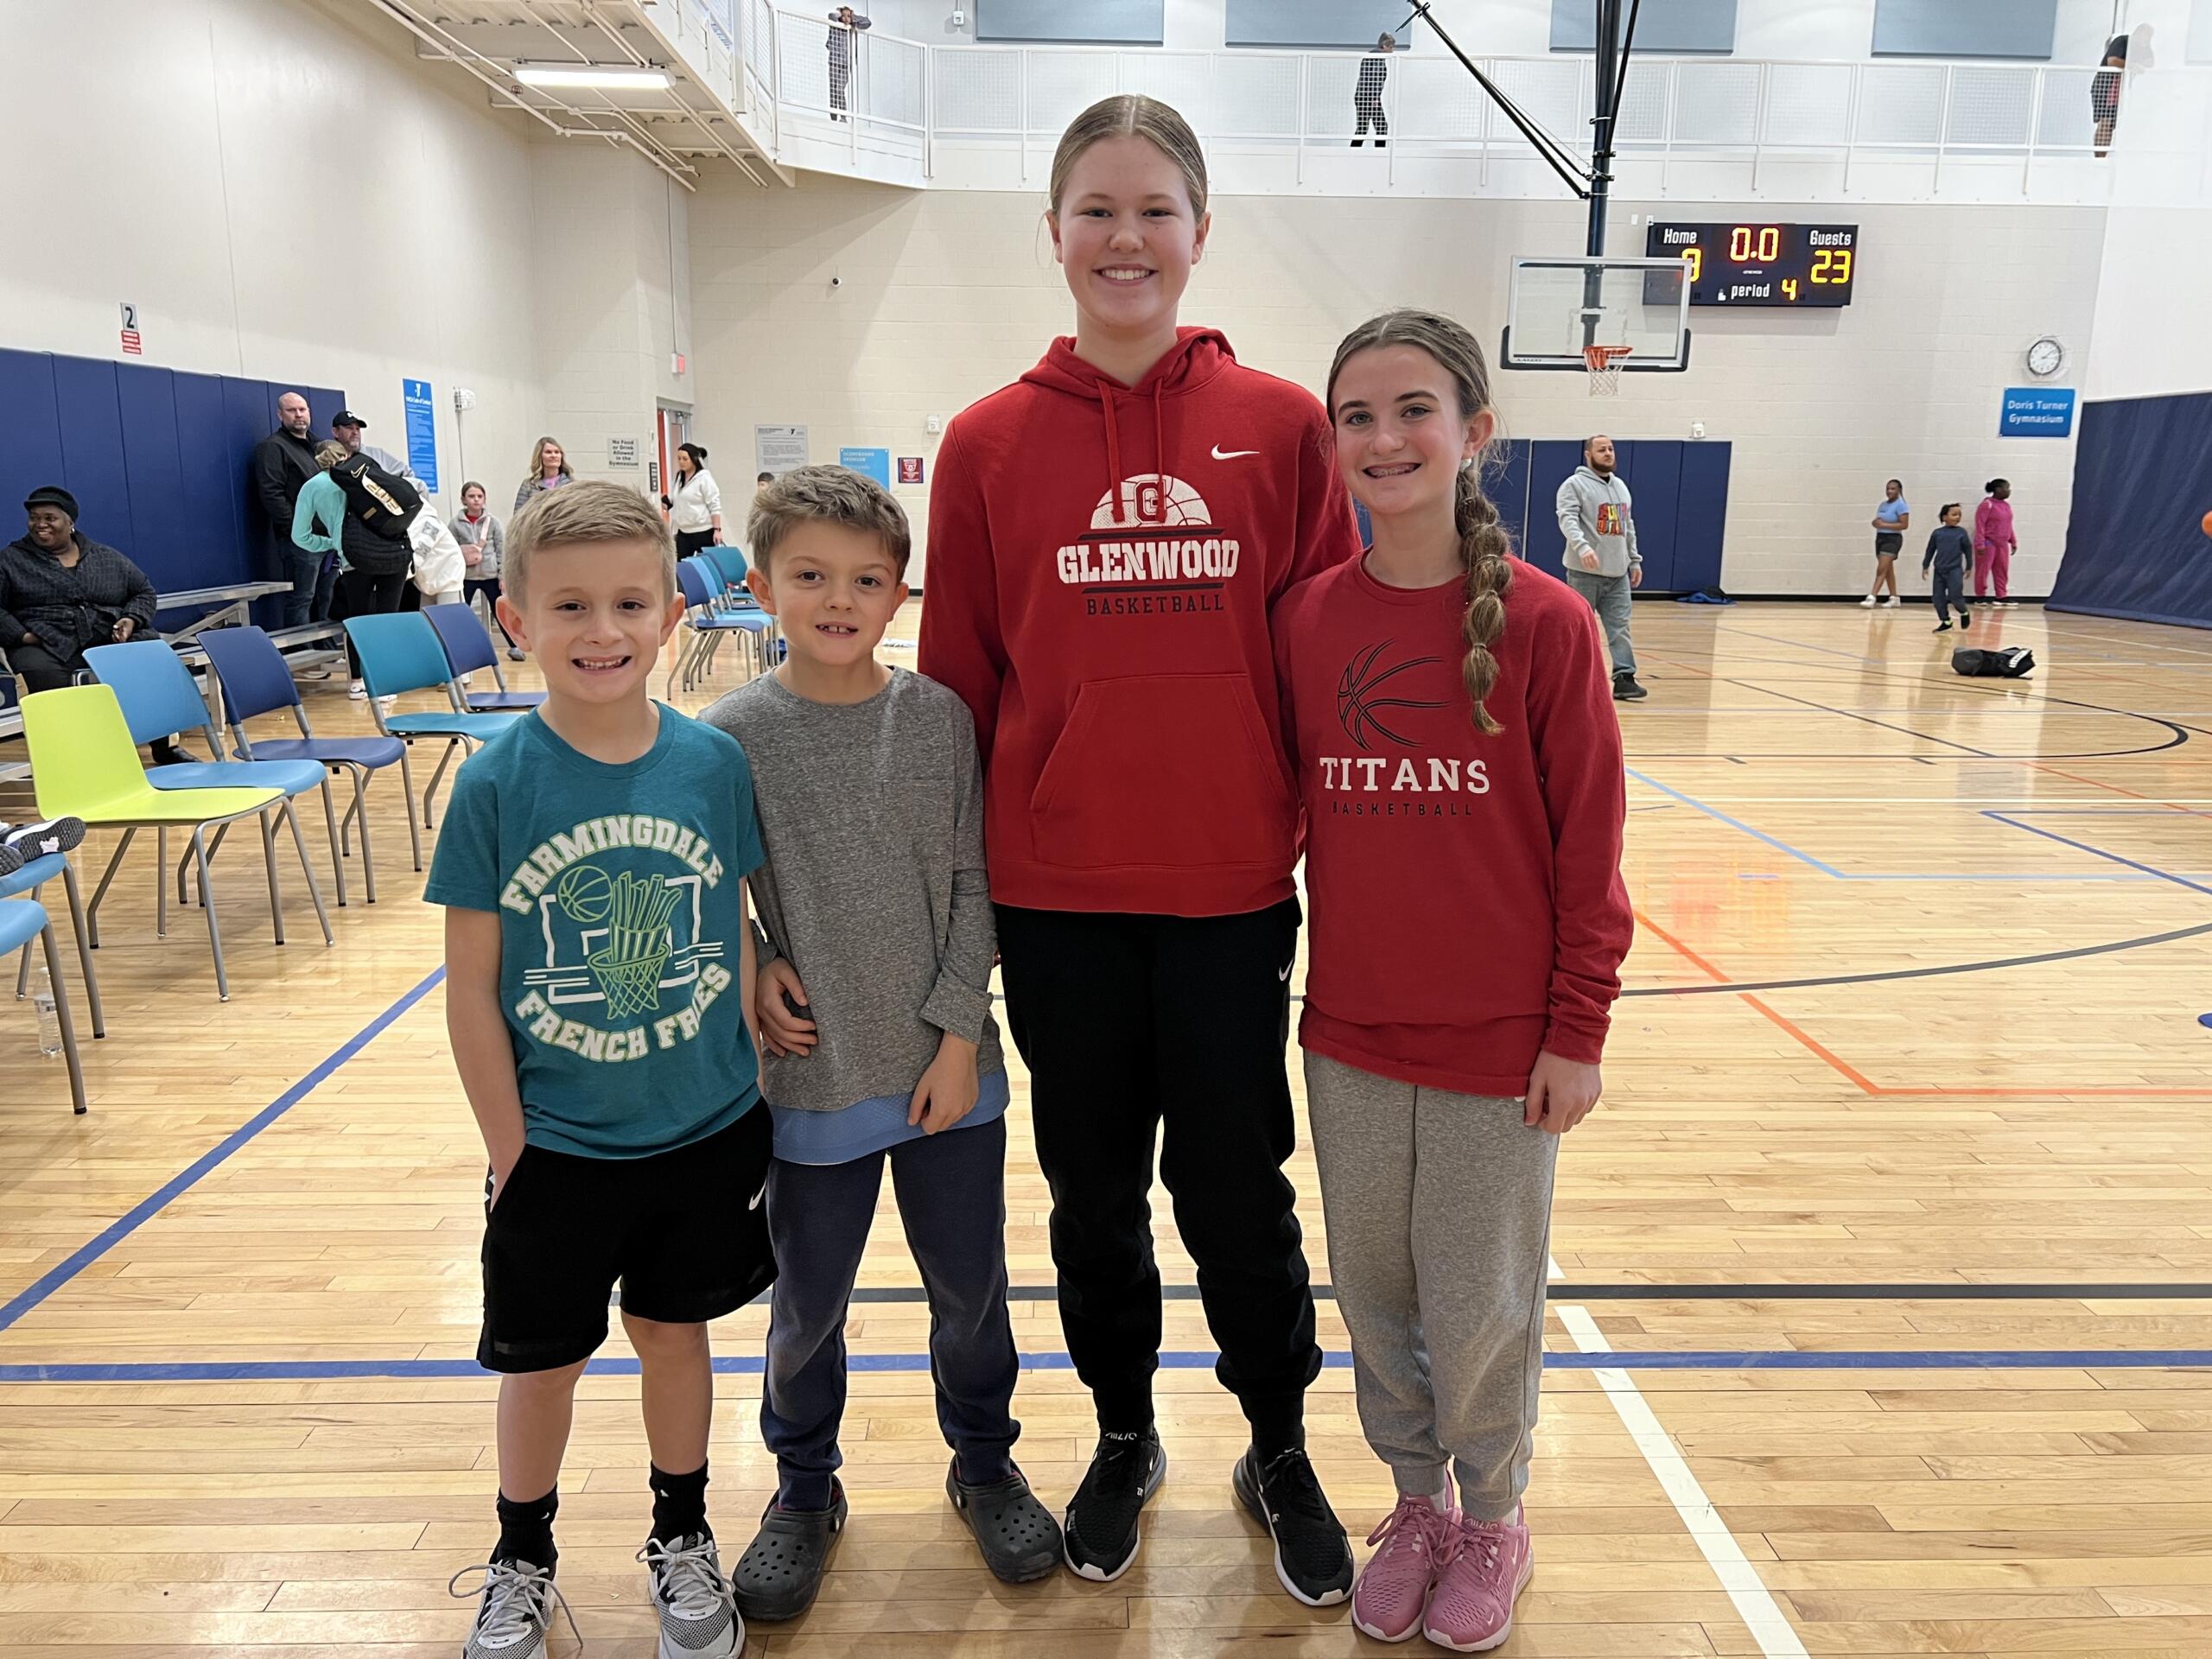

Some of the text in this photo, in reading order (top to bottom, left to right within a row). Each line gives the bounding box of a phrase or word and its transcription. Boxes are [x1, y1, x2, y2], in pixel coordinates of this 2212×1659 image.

[1663, 228, 1697, 245] Home
[1730, 227, 1780, 262] 0.0
[1810, 230, 1852, 246] Guests
[1810, 250, 1852, 283] 23
[1731, 279, 1797, 301] period 4
[124, 306, 135, 329] 2
[2007, 400, 2069, 410] Doris Turner
[2009, 413, 2064, 424] Gymnasium
[1057, 539, 1240, 584] GLENWOOD
[1087, 594, 1224, 615] BASKETBALL
[1319, 757, 1490, 793] TITANS
[1332, 801, 1471, 816] BASKETBALL
[499, 814, 724, 915] FARMINGDALE
[515, 989, 648, 1062] FRENCH
